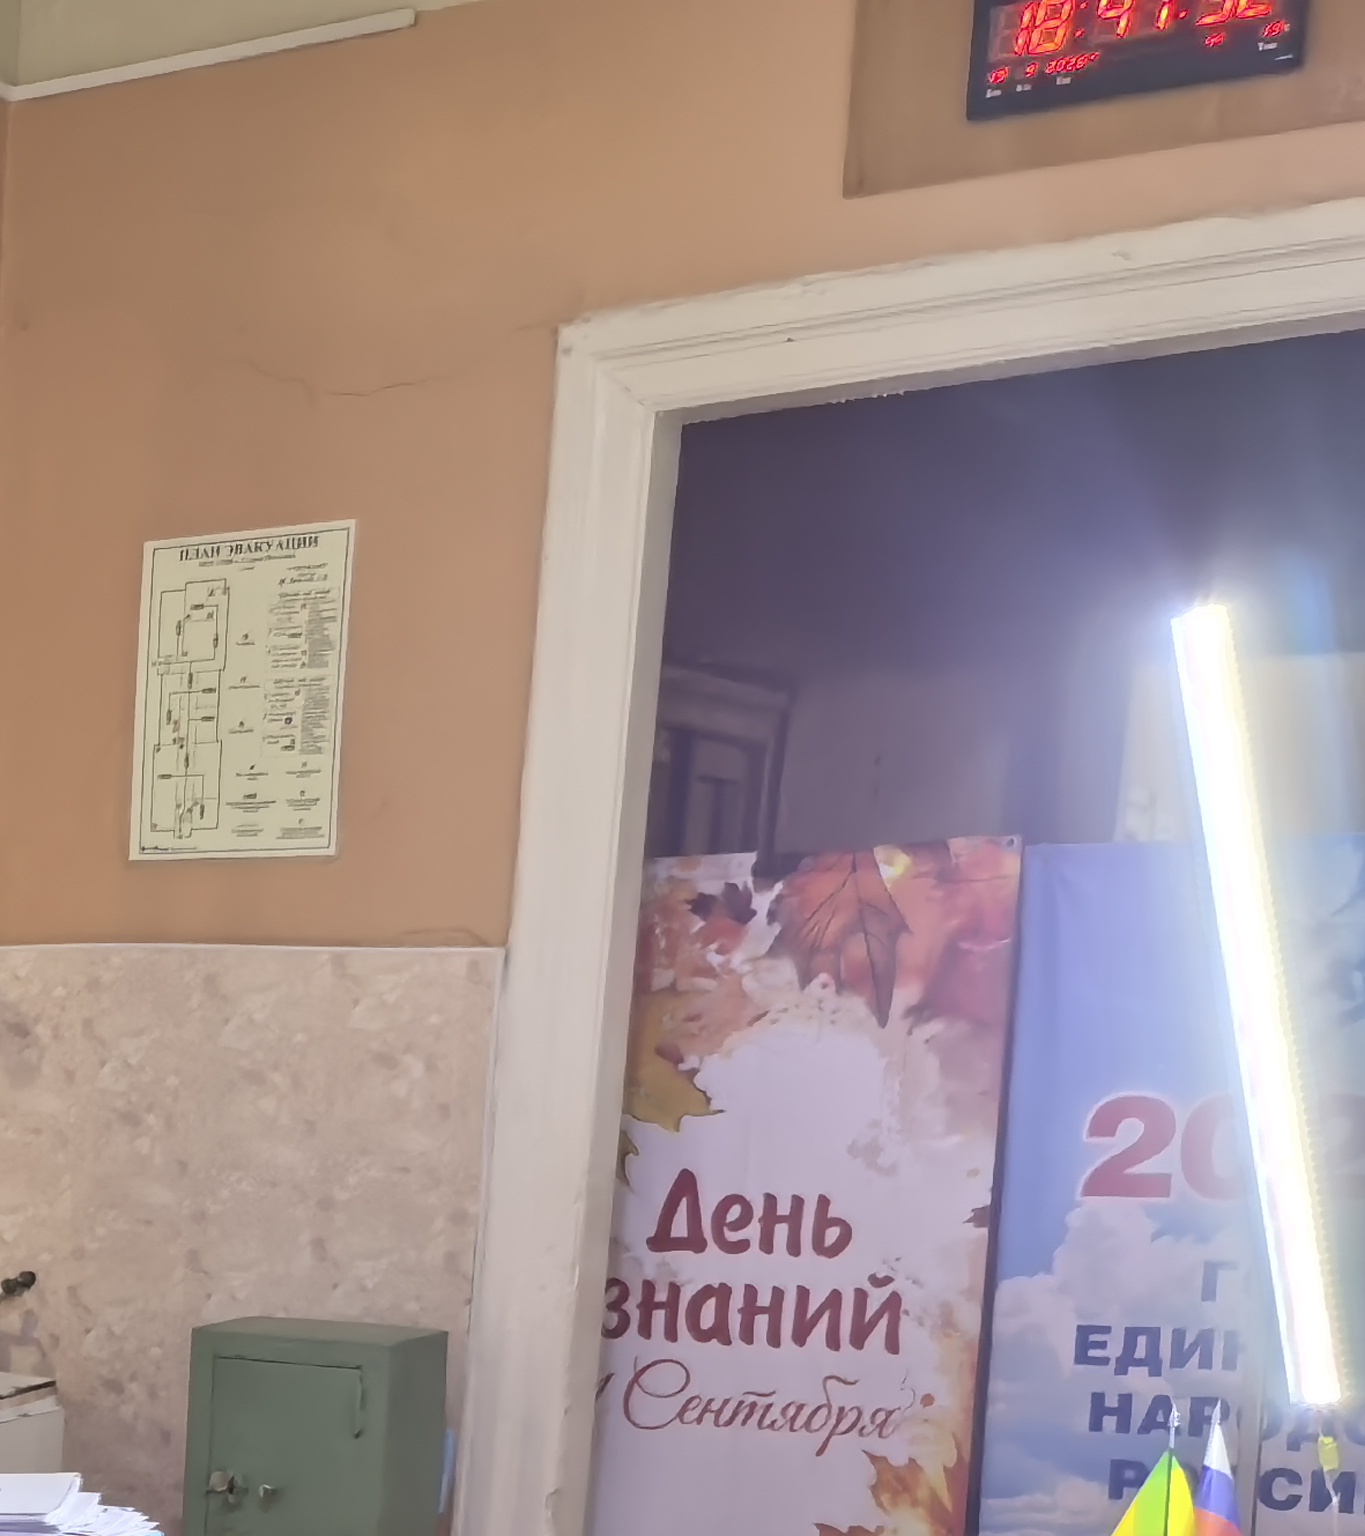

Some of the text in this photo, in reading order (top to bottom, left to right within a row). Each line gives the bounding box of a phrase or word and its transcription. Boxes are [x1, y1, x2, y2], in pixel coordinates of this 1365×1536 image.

[646, 1168, 853, 1259] День
[601, 1273, 903, 1355] знаний
[622, 1356, 903, 1457] Сентября
